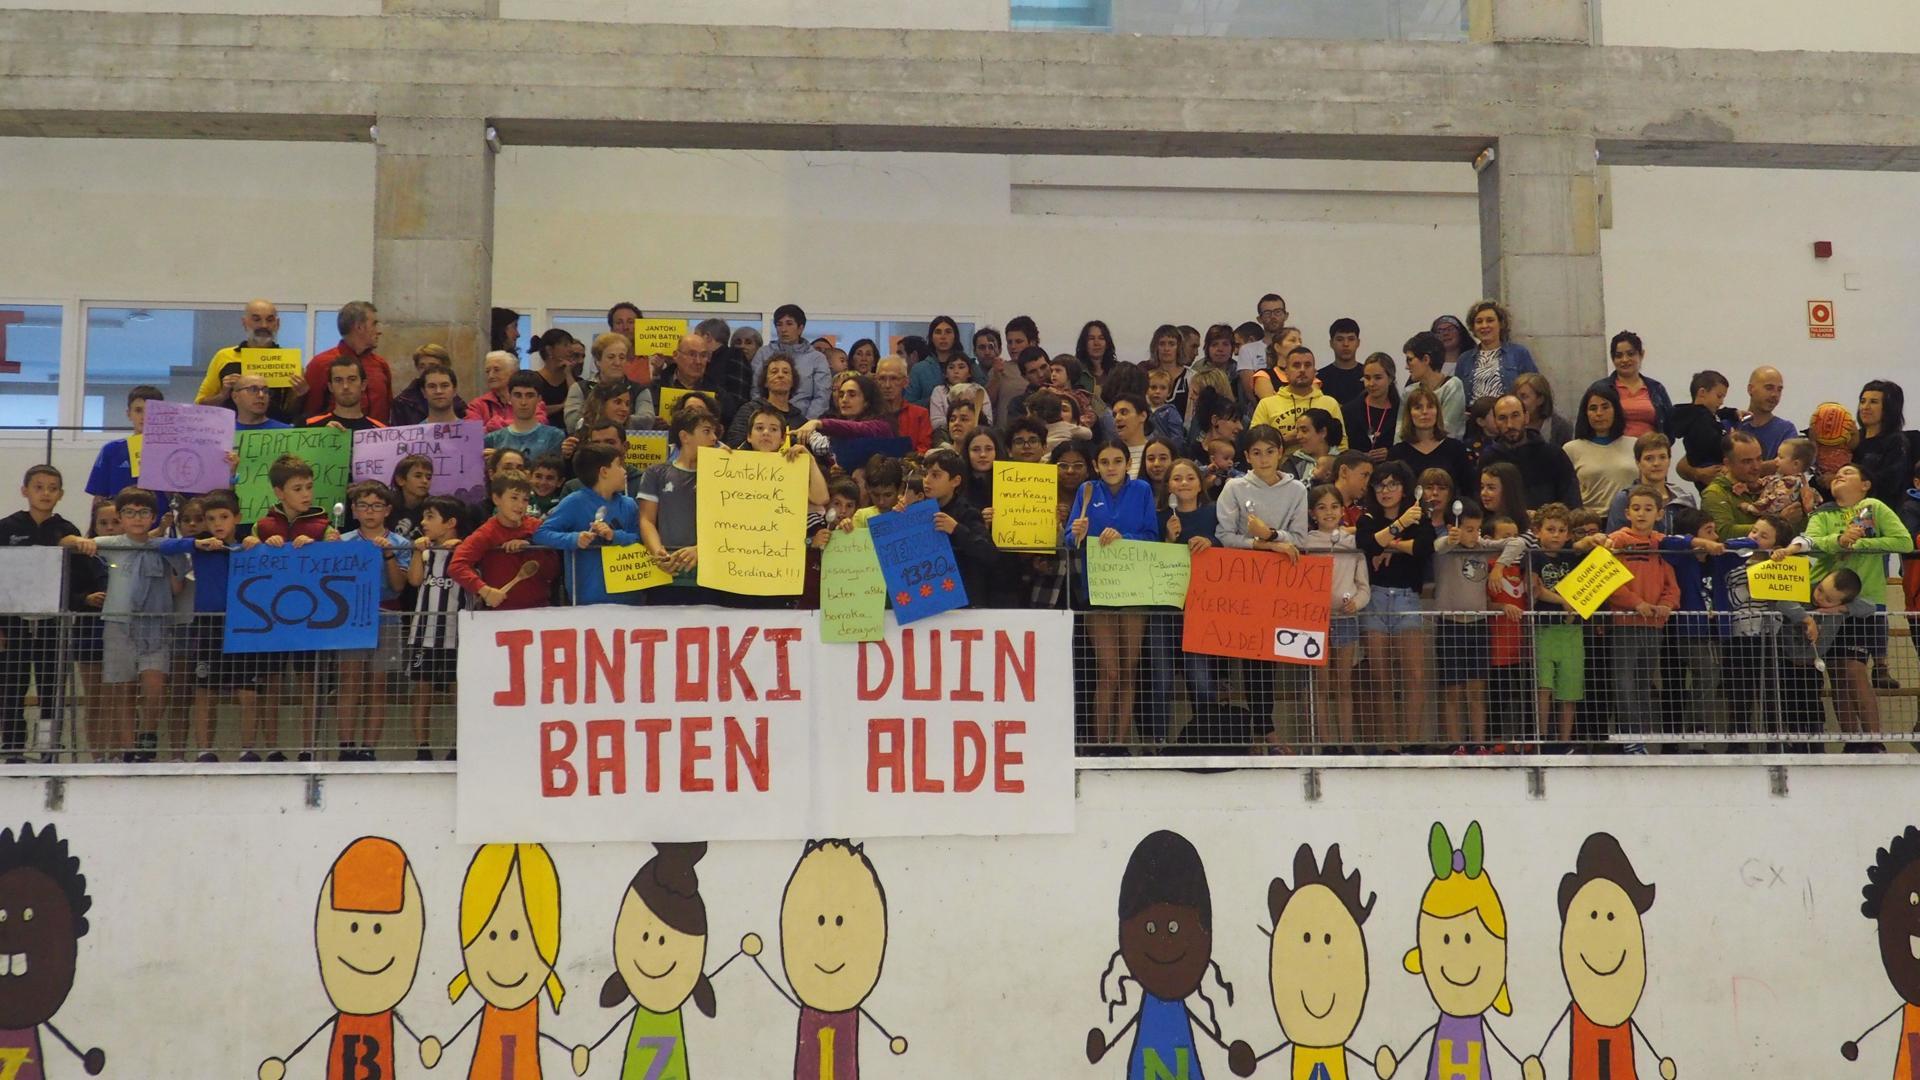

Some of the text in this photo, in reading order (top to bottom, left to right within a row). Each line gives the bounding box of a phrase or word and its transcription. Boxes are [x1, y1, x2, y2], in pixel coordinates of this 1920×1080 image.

[774, 503, 795, 515] eta
[233, 554, 373, 575] HERRI TXIKIAK
[609, 563, 633, 573] DUIN
[1760, 563, 1797, 571] JANTOKI
[424, 574, 454, 589] Jeep
[1206, 557, 1328, 593] JANTOKI
[1777, 573, 1805, 582] BATEN
[1272, 599, 1329, 624] BATEN
[493, 626, 1035, 706] JANTOKI DUIN
[540, 717, 1026, 797] BATEN ALDE
